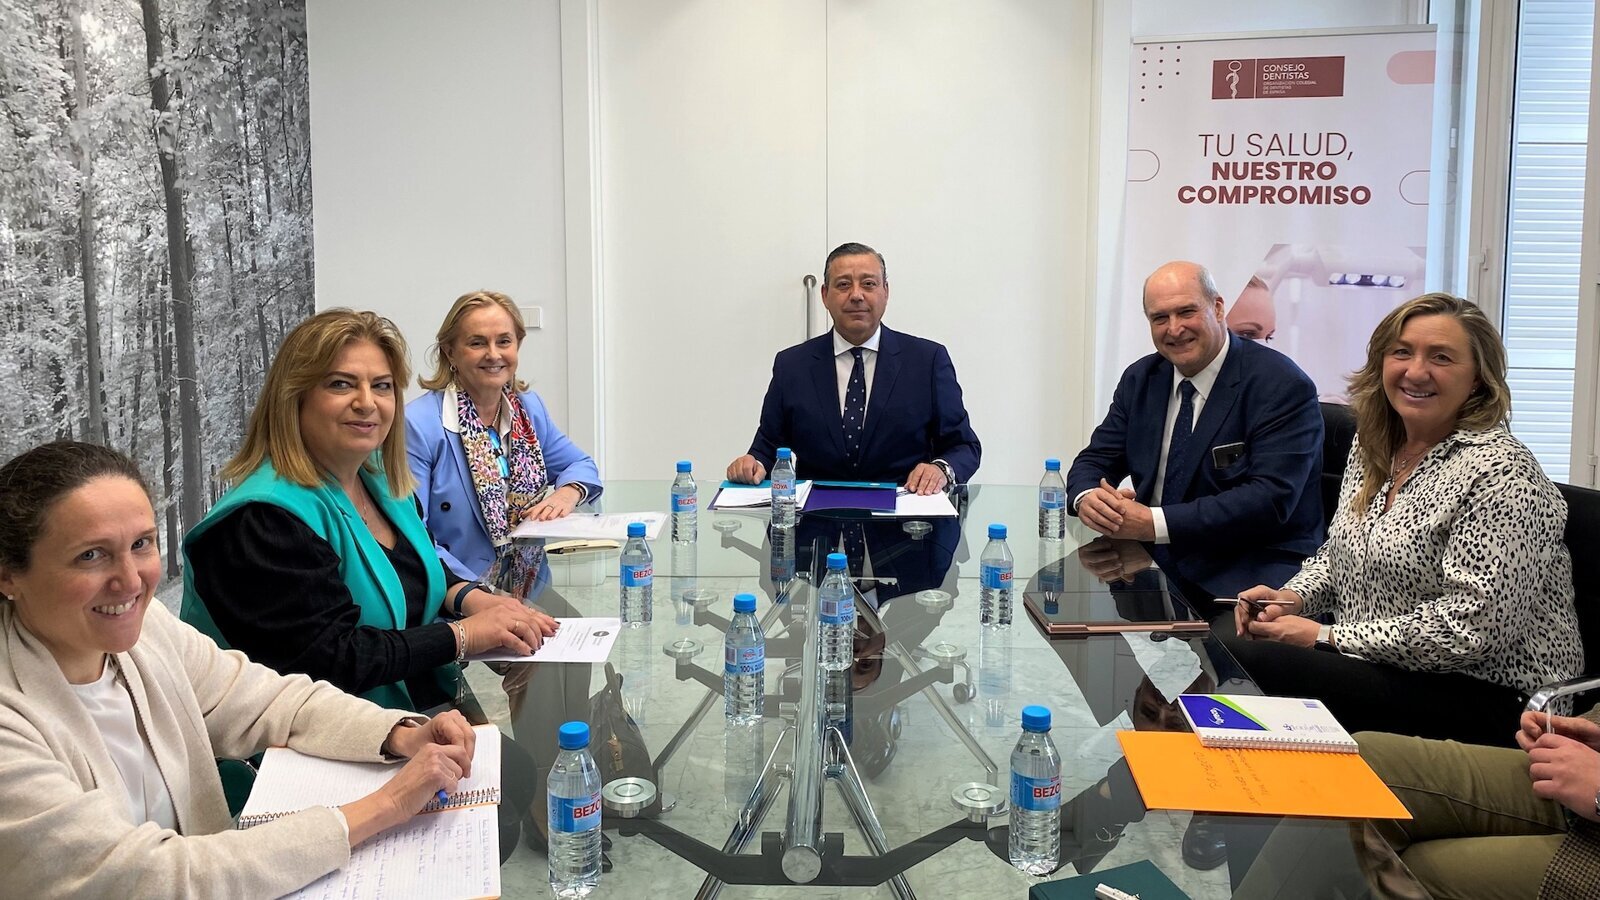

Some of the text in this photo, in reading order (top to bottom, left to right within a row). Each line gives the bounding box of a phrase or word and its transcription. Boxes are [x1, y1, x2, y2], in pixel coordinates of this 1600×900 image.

[1263, 63, 1306, 72] CONSEJO
[1263, 72, 1310, 80] DENTISTAS
[1198, 132, 1354, 160] TU SALUD,
[1211, 161, 1338, 181] NUESTRO
[1177, 185, 1372, 206] COMPROMISO
